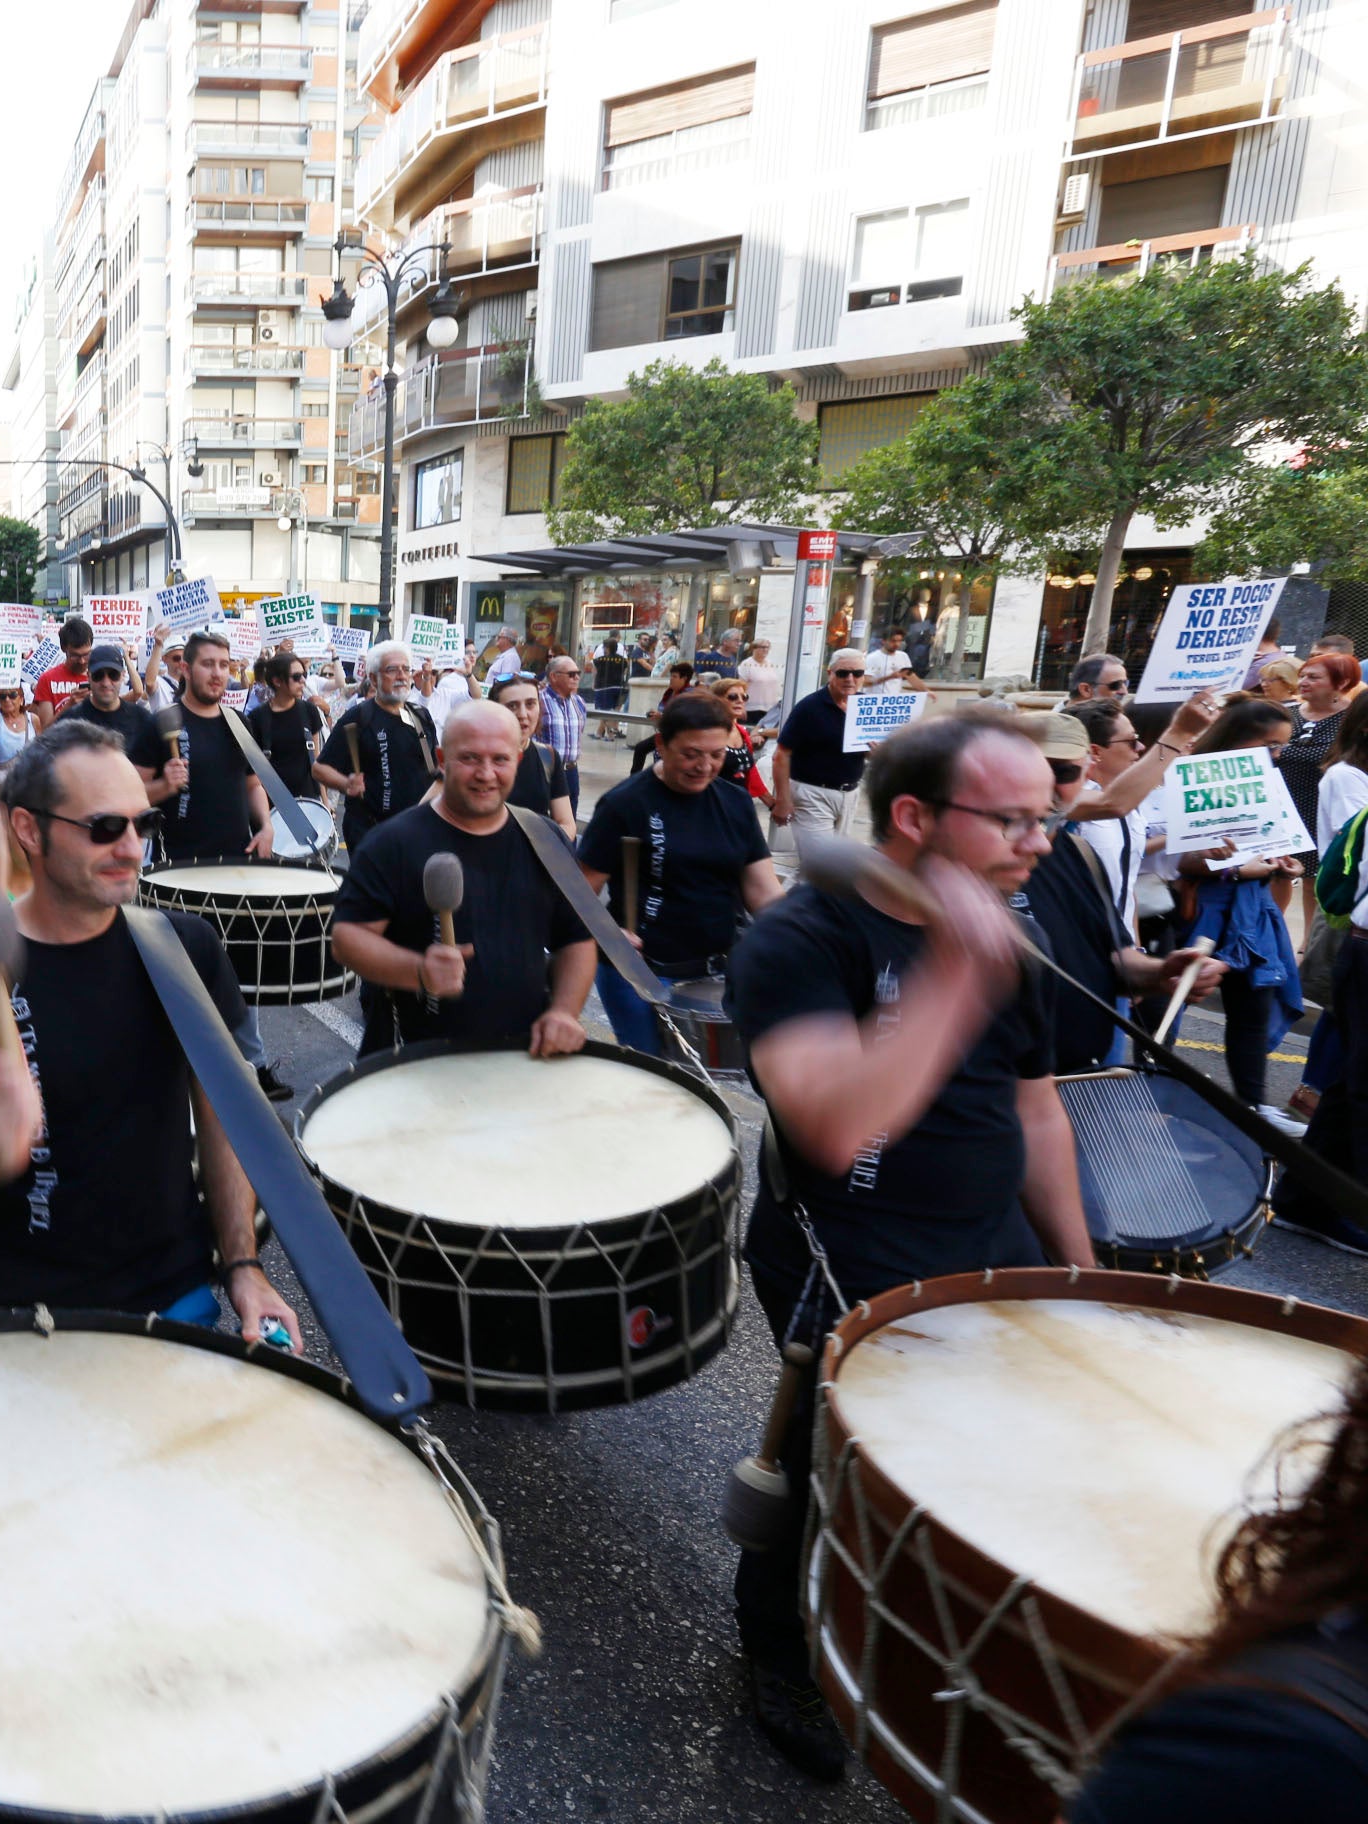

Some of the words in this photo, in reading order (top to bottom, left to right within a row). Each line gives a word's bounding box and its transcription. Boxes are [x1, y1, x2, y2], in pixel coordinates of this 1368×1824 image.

[810, 536, 835, 545] EMT
[401, 542, 459, 565] CORTEFIEL
[156, 590, 175, 600] SER
[176, 579, 206, 593] POCOS
[161, 597, 174, 608] NO
[175, 588, 206, 602] RESTA
[1187, 587, 1227, 608] SER
[1229, 582, 1275, 605] POCOS
[90, 599, 143, 613] TERUEL
[162, 595, 210, 617] DERECHOS
[260, 594, 315, 614] TERUEL
[92, 614, 140, 626] EXISTE
[264, 608, 315, 628] EXISTE
[1185, 608, 1215, 629] NO
[1218, 604, 1264, 627] RESTA
[346, 629, 365, 638] POCOS
[1176, 624, 1259, 650] DERECHOS
[22, 658, 35, 674] SER
[33, 636, 51, 659] POCOS
[28, 663, 39, 676] NO
[38, 642, 55, 664] RESTA
[1186, 652, 1220, 664] TERUEL
[857, 697, 877, 707] SER
[882, 695, 916, 705] POCOS
[859, 706, 873, 716] NO
[876, 705, 911, 715] RESTA
[856, 714, 911, 726] DERECHOS
[1176, 755, 1264, 786] TERUEL
[1183, 781, 1267, 814] EXISTE
